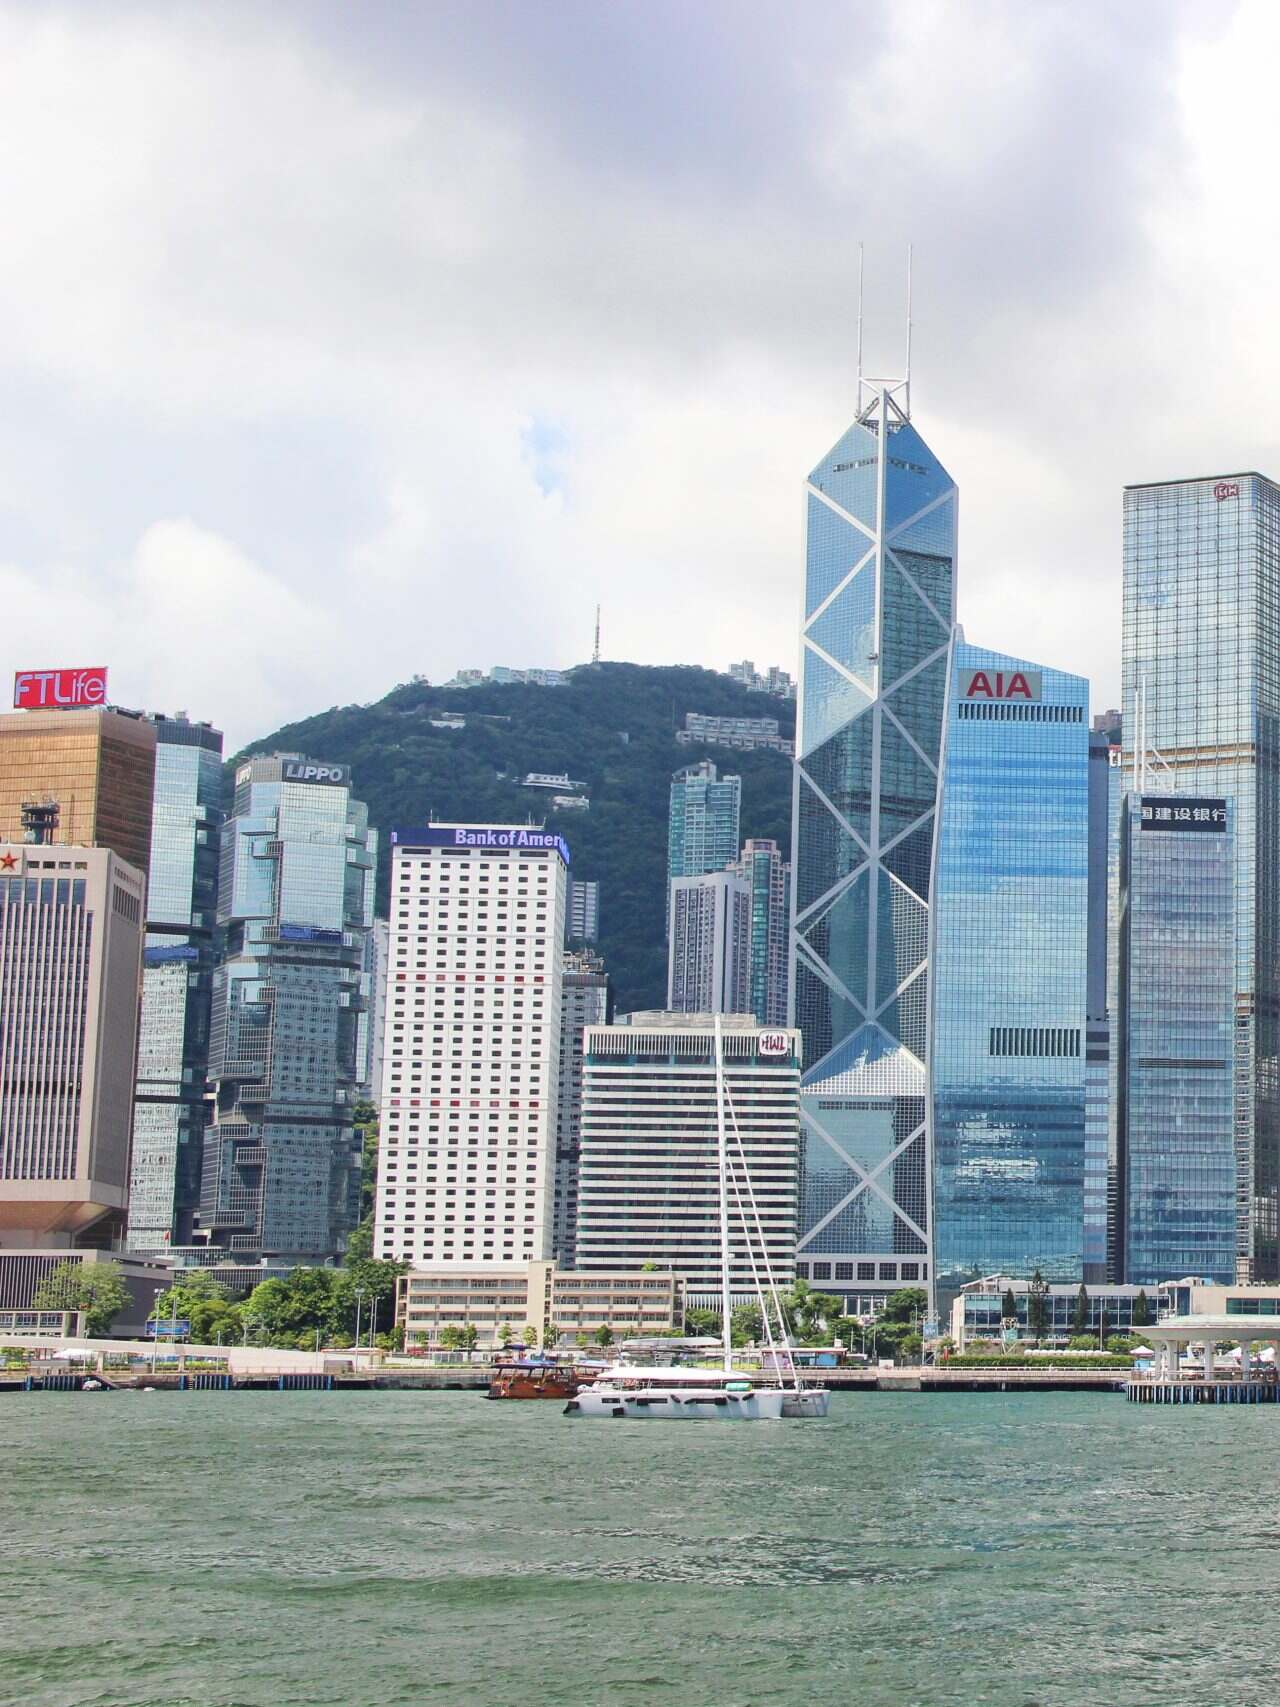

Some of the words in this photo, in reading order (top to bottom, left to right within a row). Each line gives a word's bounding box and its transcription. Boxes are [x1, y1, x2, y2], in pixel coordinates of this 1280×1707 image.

[15, 672, 104, 705] FTLife
[966, 672, 1032, 698] AIA
[286, 764, 343, 782] LIPPO
[455, 829, 496, 845] Bank
[499, 830, 516, 845] of
